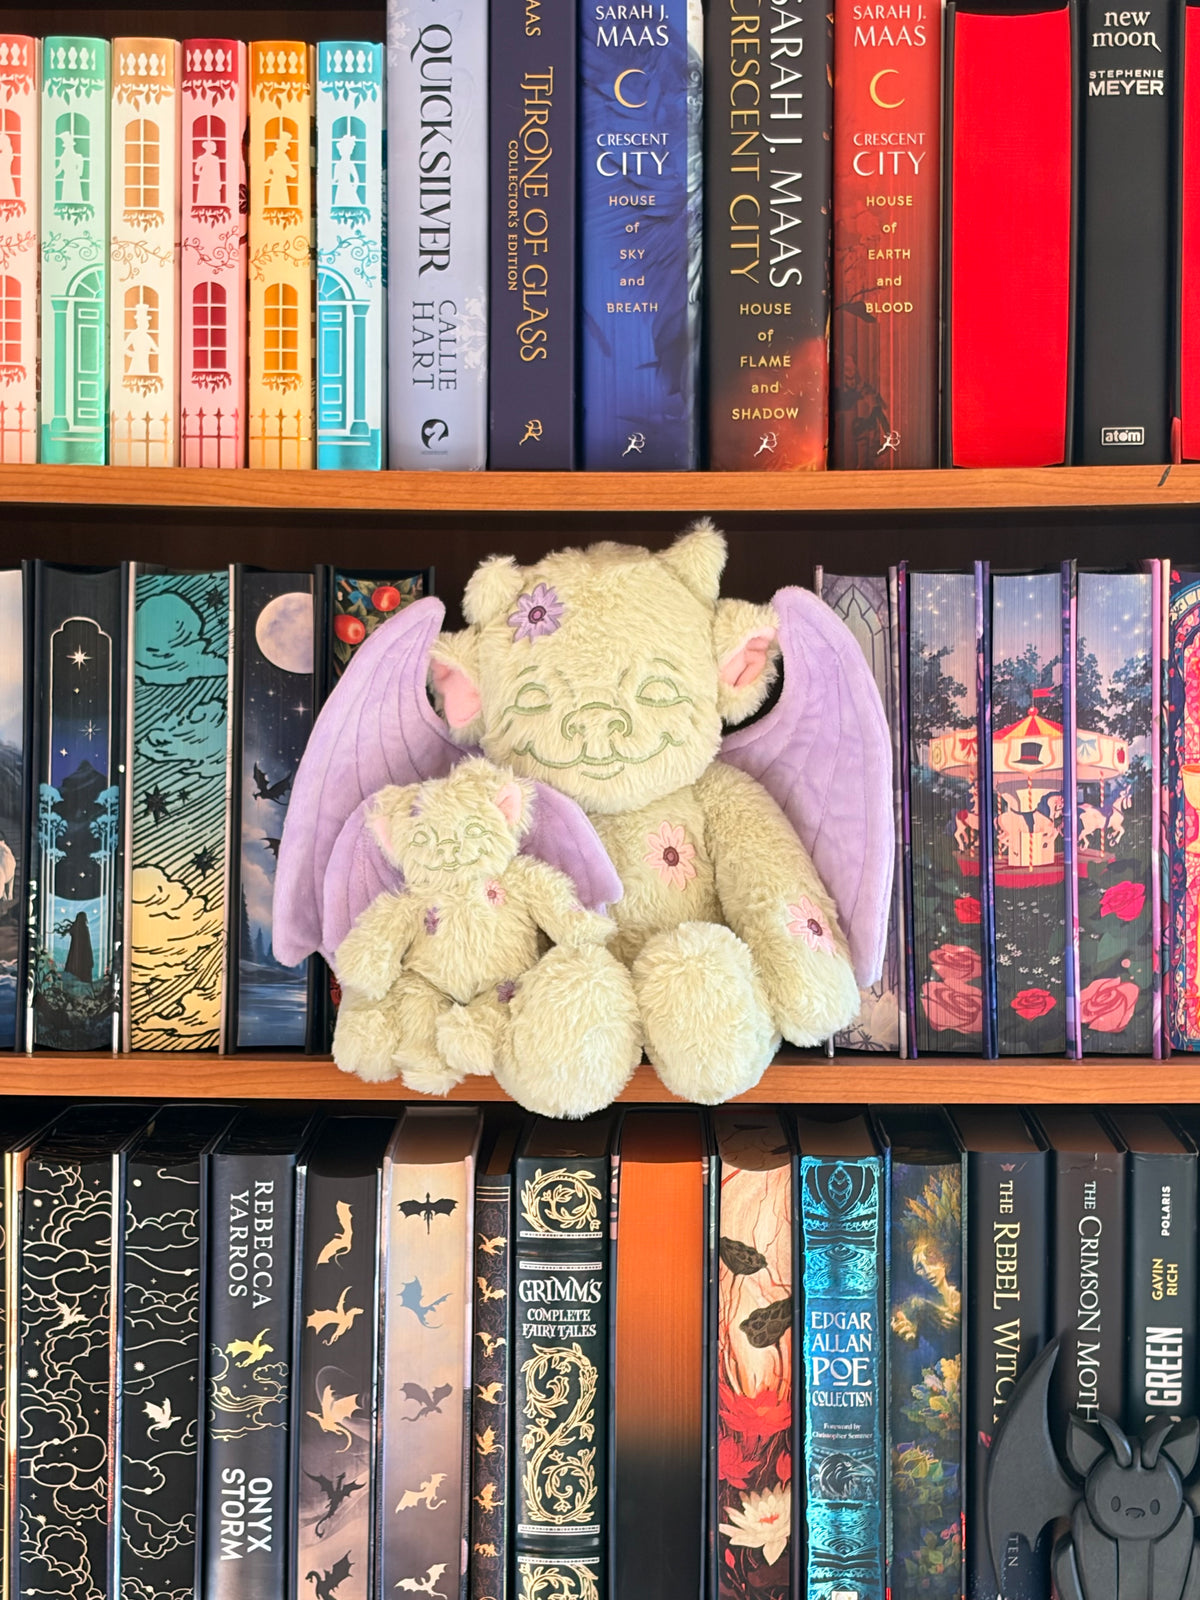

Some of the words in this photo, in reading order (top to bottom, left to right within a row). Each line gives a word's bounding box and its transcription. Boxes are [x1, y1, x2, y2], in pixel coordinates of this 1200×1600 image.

[595, 5, 653, 21] SARAH
[658, 5, 669, 22] J.
[853, 5, 910, 21] SARAH
[917, 5, 926, 22] J.
[1103, 11, 1151, 27] new
[596, 25, 669, 48] MAAS
[854, 25, 926, 47] MAAS
[1092, 31, 1162, 53] moon
[770, 0, 803, 119] ARAH
[1089, 69, 1164, 79] STEPHENIE
[1088, 80, 1164, 97] MEYER
[519, 66, 554, 198] THRONE
[597, 133, 669, 147] CRESCENT
[761, 132, 803, 154] J.
[853, 133, 926, 146] CRESCENT
[410, 24, 452, 278] QUICKSILVER
[596, 152, 670, 177] CITY
[853, 151, 926, 177] CITY
[508, 139, 520, 229] COLLECTOR'S
[608, 195, 656, 207] HOUSE
[866, 195, 913, 207] HOUSE
[523, 208, 549, 256] OF
[625, 222, 640, 233] of
[769, 169, 802, 288] MAAS
[882, 222, 897, 233] of
[729, 194, 760, 284] CITY
[507, 233, 518, 291] EDITION
[620, 249, 645, 260] SKY
[868, 249, 911, 260] EARTH
[620, 275, 645, 287] and
[876, 275, 902, 287] and
[516, 264, 549, 362] GLASS
[606, 302, 659, 313] BREATH
[740, 303, 792, 315] HOUSE
[865, 302, 914, 313] BLOOD
[412, 301, 435, 390] HART
[438, 300, 457, 391] CALLIE
[757, 329, 774, 342] of
[740, 355, 792, 368] FLAME
[751, 381, 780, 394] and
[732, 407, 799, 420] SHADOW
[1105, 429, 1141, 442] atom
[1000, 1180, 1013, 1214] THE
[1084, 1181, 1097, 1210] THE
[1161, 1185, 1171, 1237] POLARIS
[228, 1189, 250, 1297] YARROS
[252, 1180, 274, 1309] REBECCA
[993, 1221, 1020, 1310] REBEL
[1076, 1215, 1102, 1333] CRIMSON
[518, 1276, 603, 1305] GRIMM'S
[1152, 1258, 1164, 1301] GAVIN
[1166, 1263, 1179, 1296] RICH
[527, 1307, 591, 1322] COMPLETE
[811, 1311, 873, 1331] EDGAR
[522, 1323, 556, 1339] FAIRY
[557, 1323, 597, 1340] TALES
[811, 1333, 872, 1353] ALLAN
[812, 1356, 873, 1387] POE
[1145, 1326, 1183, 1407] GREEN
[1076, 1341, 1101, 1424] MOTH
[812, 1390, 873, 1408] COLLECTION
[220, 1467, 246, 1561] STORM
[247, 1477, 273, 1553] ONYX
